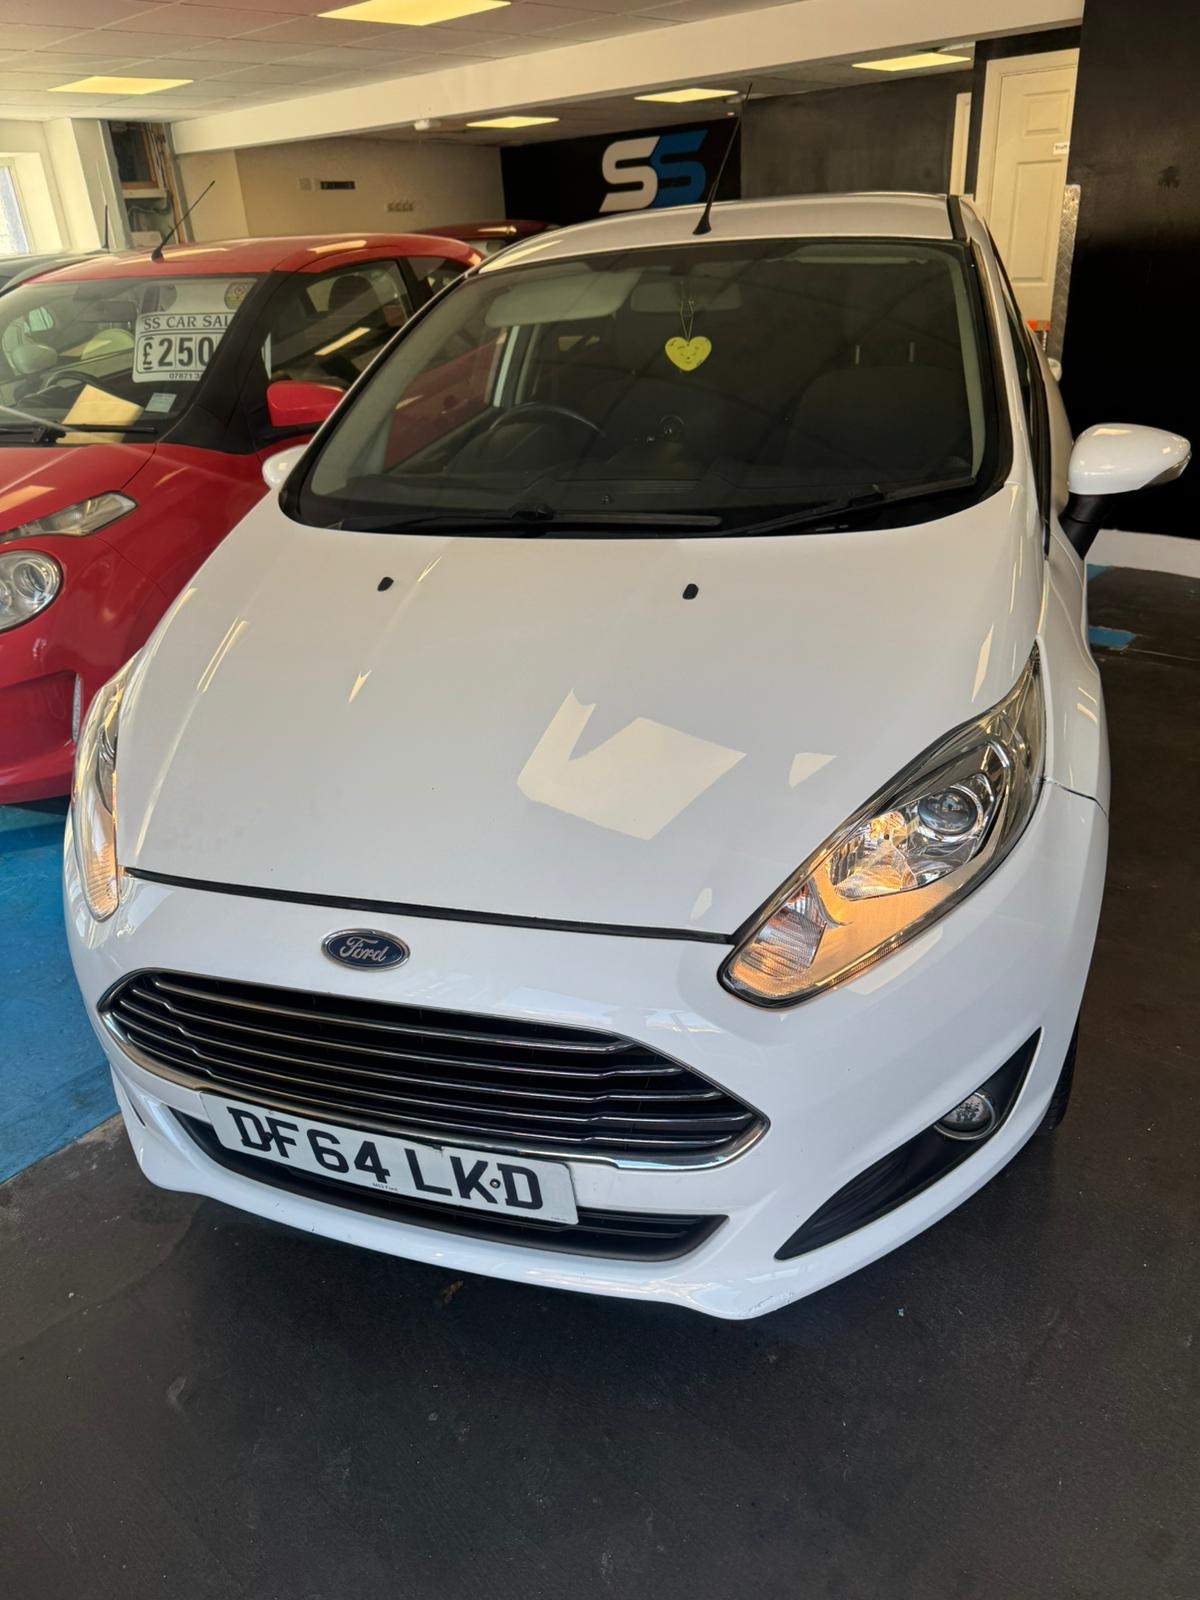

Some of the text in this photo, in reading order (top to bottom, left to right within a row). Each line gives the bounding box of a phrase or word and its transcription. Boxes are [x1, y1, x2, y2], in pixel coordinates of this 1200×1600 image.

[599, 129, 708, 212] SS
[144, 317, 161, 329] SS
[166, 316, 197, 328] CAR
[340, 936, 389, 962] Ford
[226, 1106, 544, 1210] DF64 LKD
